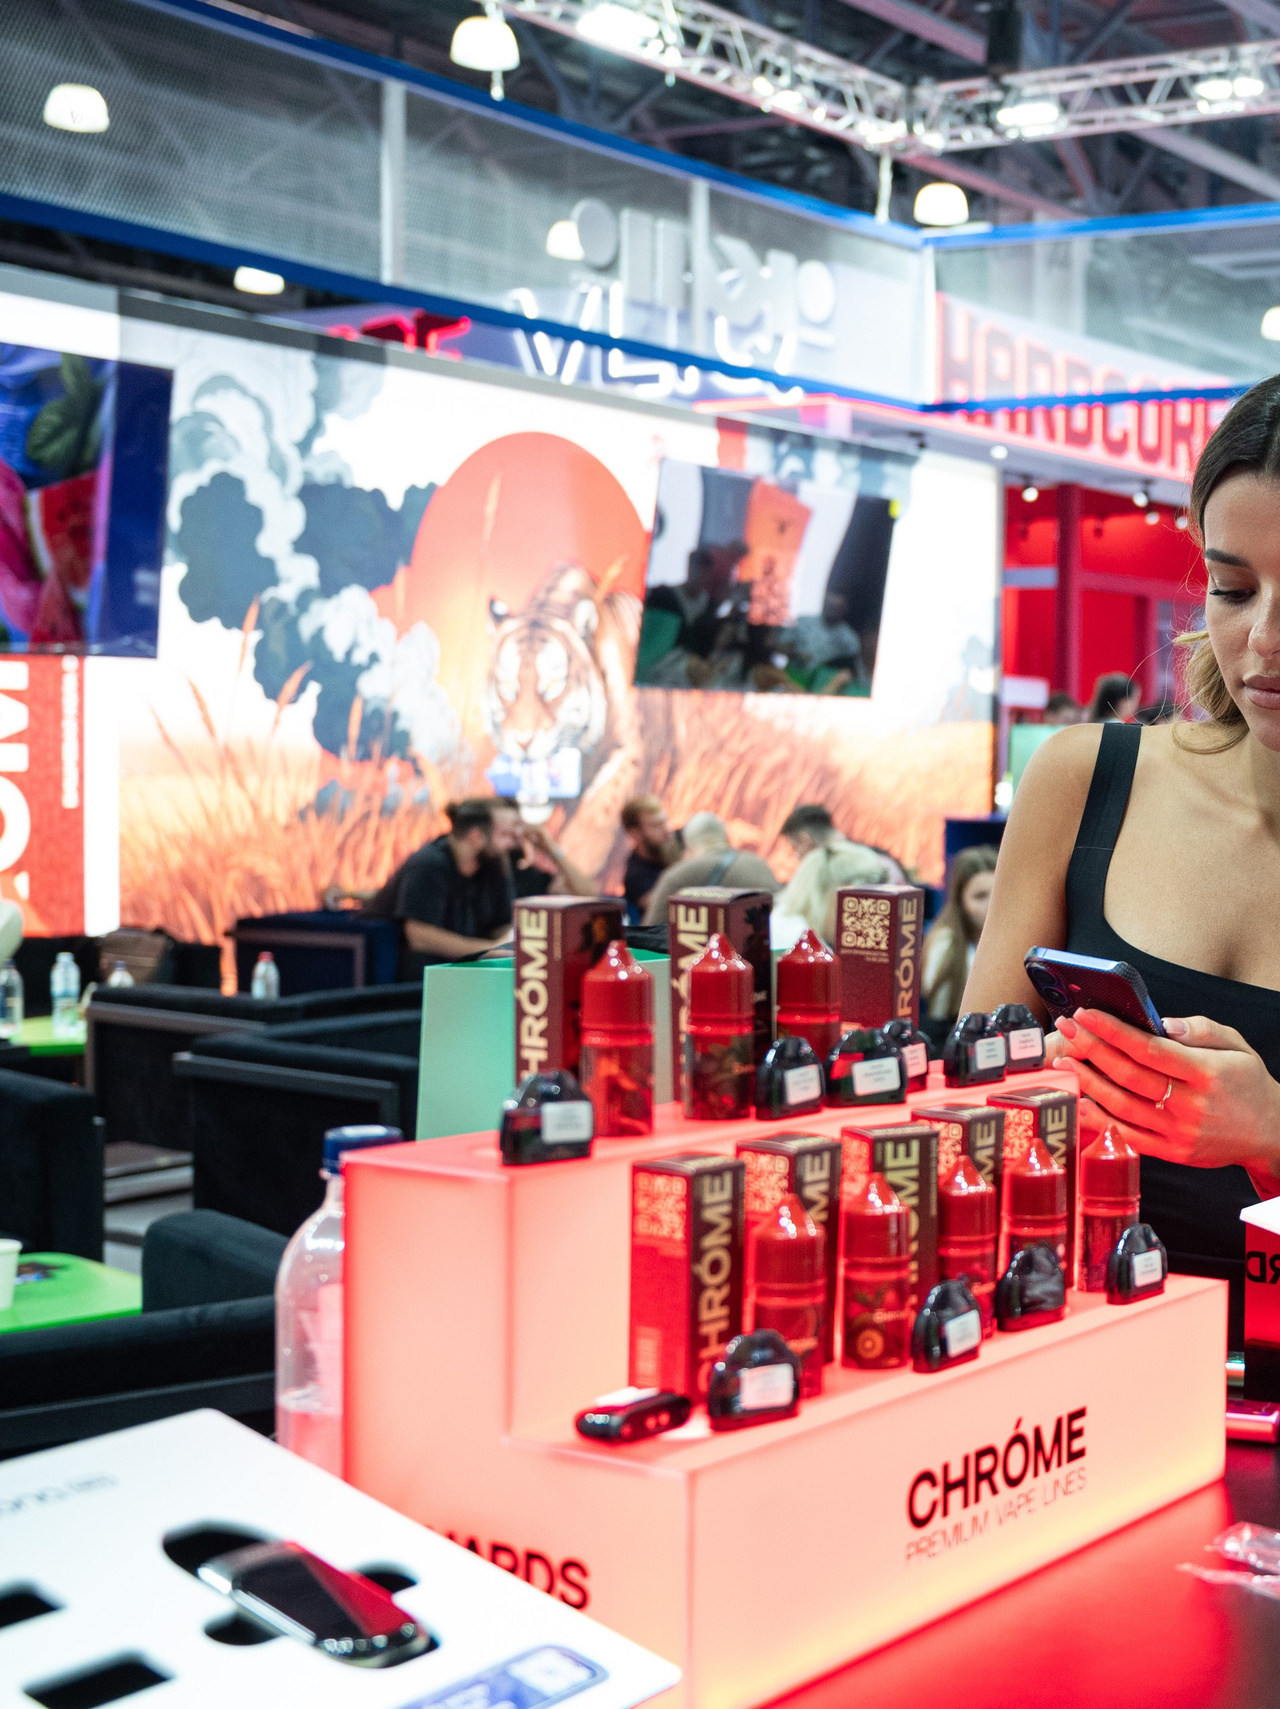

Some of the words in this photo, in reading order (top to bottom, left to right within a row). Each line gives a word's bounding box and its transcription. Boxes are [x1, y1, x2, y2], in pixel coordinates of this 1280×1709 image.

[514, 908, 550, 1077] HRÓME
[895, 898, 918, 1018] RÓME
[905, 1509, 990, 1562] PREMIUM
[995, 1487, 1036, 1526] VAPE
[1043, 1466, 1088, 1507] LINES
[906, 1405, 1087, 1530] CHRÓME
